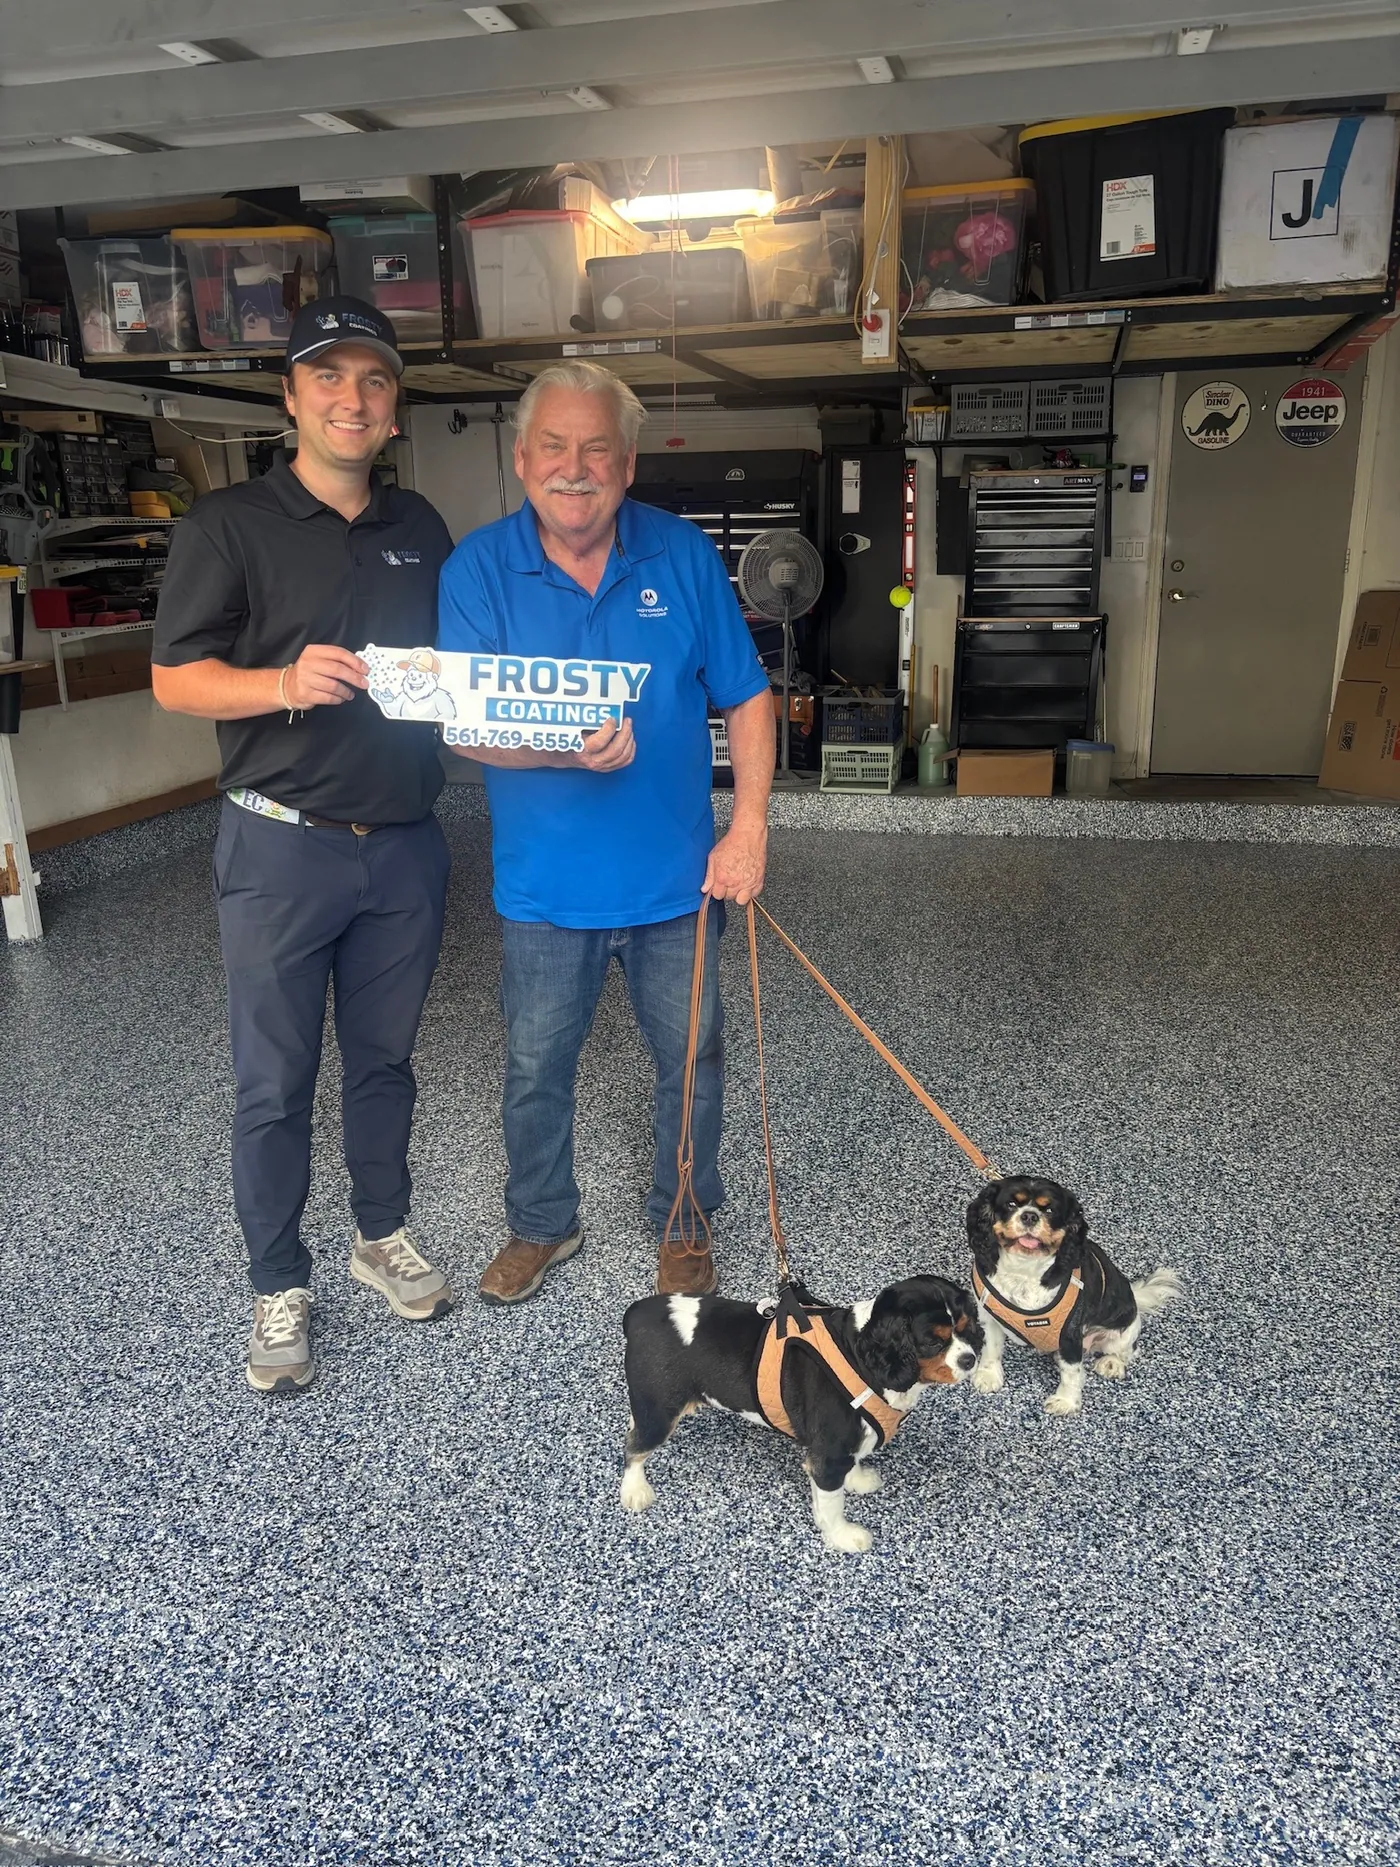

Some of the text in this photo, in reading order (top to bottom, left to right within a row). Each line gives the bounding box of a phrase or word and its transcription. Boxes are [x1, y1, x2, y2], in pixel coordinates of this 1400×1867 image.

[1106, 181, 1127, 192] HDX
[1281, 178, 1313, 228] J
[115, 288, 133, 297] HDX
[341, 312, 382, 333] FROSTY
[1206, 390, 1231, 398] Sinclair
[1302, 386, 1325, 396] 1941
[1283, 402, 1338, 423] Jeep
[470, 656, 649, 699] FROSTY
[496, 700, 612, 725] COATINGS
[446, 726, 583, 750] 561-769-5554
[242, 789, 265, 812] EC
